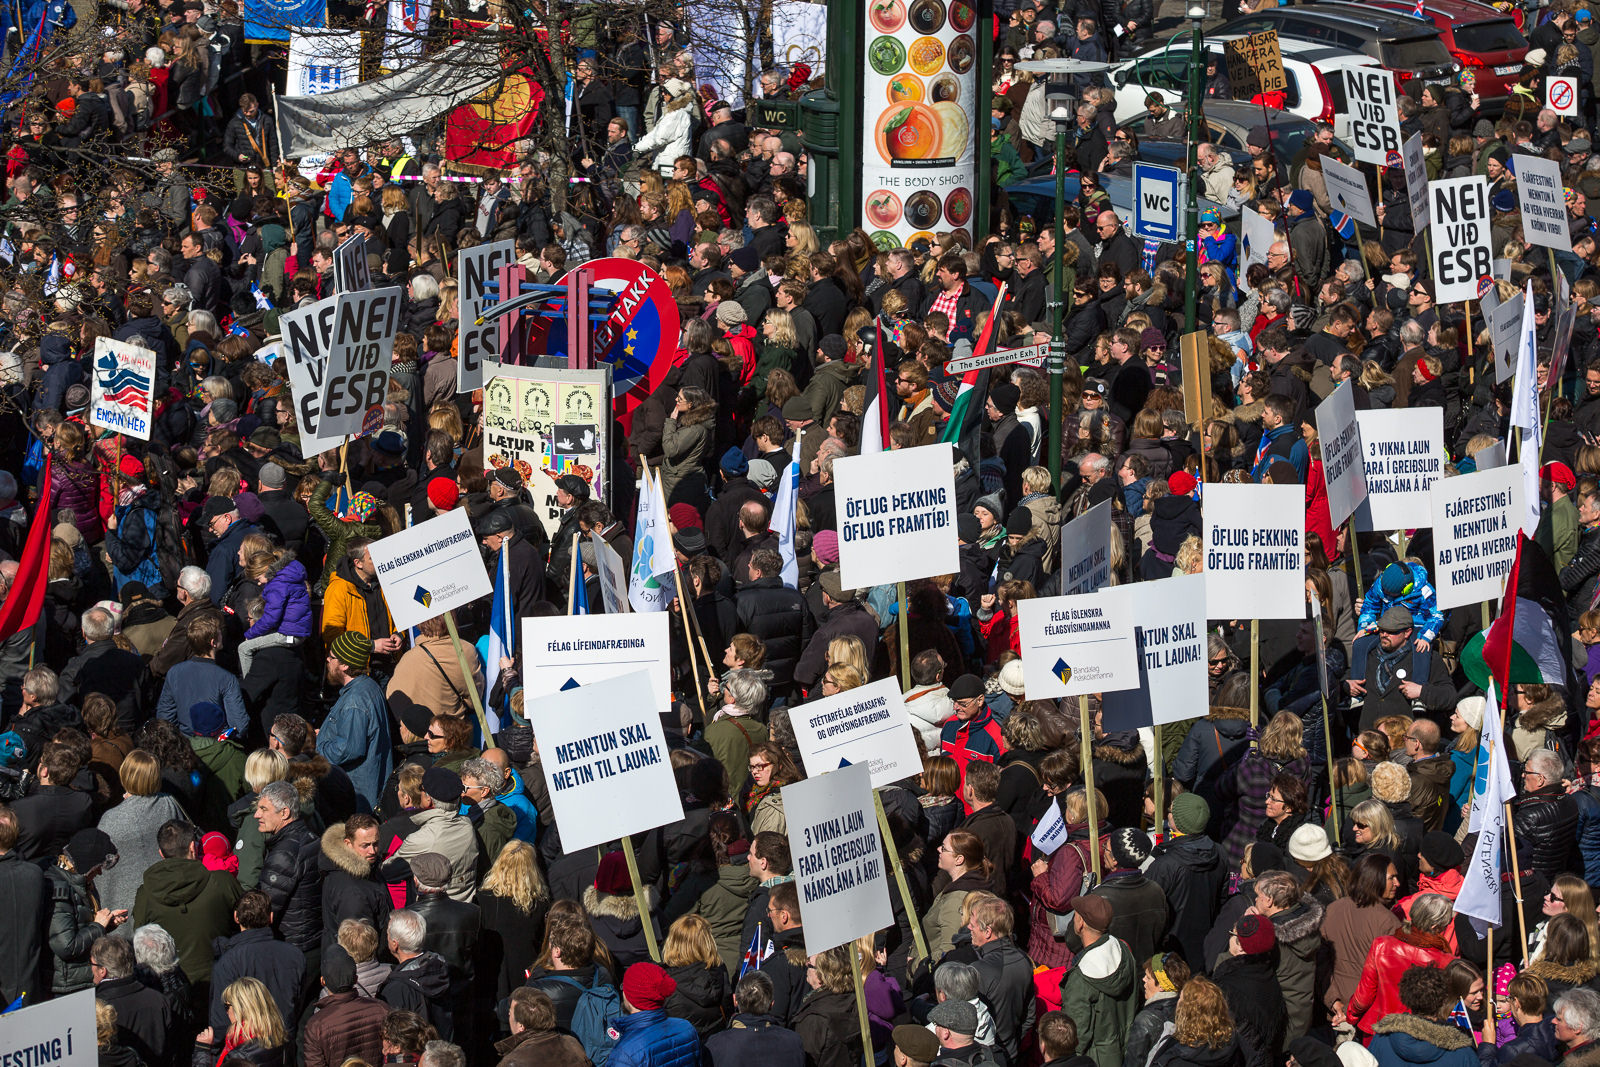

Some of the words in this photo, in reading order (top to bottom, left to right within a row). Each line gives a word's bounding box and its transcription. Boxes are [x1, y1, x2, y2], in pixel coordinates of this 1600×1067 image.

[1346, 70, 1391, 105] NEI
[764, 110, 787, 123] WC
[1356, 101, 1385, 123] VIÐ
[1352, 120, 1399, 153] ESB
[878, 176, 900, 186] THE
[905, 176, 936, 187] BODY
[939, 174, 964, 186] SHOP
[1143, 192, 1170, 212] WC
[1435, 182, 1486, 225] NEI
[1446, 222, 1479, 248] VIÐ
[1438, 246, 1492, 285] ESB
[610, 269, 655, 324] TAKK
[337, 295, 397, 345] NEI
[345, 342, 381, 373] VIÐ
[464, 327, 500, 371] ES
[959, 362, 973, 370] The
[975, 353, 1017, 367] Settlement
[1019, 349, 1036, 358] Exh.
[325, 370, 387, 418] ESB
[96, 407, 124, 427] ENGAN
[127, 416, 146, 433] HER
[488, 432, 535, 453] LÆTUR
[1325, 436, 1341, 463] ÖFLUG
[1370, 442, 1376, 456] 3
[1378, 440, 1406, 456] VIKNA
[1408, 440, 1430, 455] LAUN
[1326, 459, 1343, 485] ÖFLUG
[1386, 457, 1390, 475] Í
[1392, 458, 1439, 474] GREIÐSLUR
[1413, 477, 1420, 492] Á
[846, 497, 888, 518] ÖFLUG
[892, 487, 947, 511] ÞEKKING
[1445, 491, 1506, 518] FJÁRFESTING
[1508, 486, 1512, 505] Í
[843, 521, 885, 542] ÖFLUG
[888, 507, 950, 536] FRAMTÍÐ!
[1212, 524, 1249, 546] ÖFLUG
[1252, 529, 1298, 546] ÞEKKING
[1453, 515, 1499, 540] MENNTUN
[1501, 511, 1508, 529] Á
[377, 561, 396, 575] FÉLAG
[393, 548, 425, 568] ÍSLENSKRA
[1208, 548, 1245, 570] ÖFLUG
[1248, 548, 1300, 570] FRAMTÍÐ!
[1439, 549, 1452, 565] AÐ
[1454, 543, 1480, 562] VERA
[1068, 554, 1094, 584] MENNTUN
[1451, 564, 1484, 586] KRÓNU
[431, 582, 456, 596] Bandalag
[1044, 620, 1111, 636] FÉLAGSVÍSINDAMANNA
[1050, 609, 1070, 622] FÉLAG
[1070, 608, 1103, 620] ÍSLENSKRA
[547, 640, 572, 652] FÉLAG
[573, 638, 645, 651] LÍFEINDAFRÆÐINGA
[1172, 622, 1197, 642] SKAL
[1073, 665, 1100, 674] Bandalag
[1145, 651, 1162, 670] TIL
[1165, 643, 1201, 667] LAUNA!
[809, 707, 854, 729] STÉTTARFÉLAG
[817, 729, 827, 741] OG
[827, 709, 891, 737] UPPLÝSINGAFRÆÐINGA
[555, 731, 619, 765] MENNTUN
[619, 722, 651, 747] SKAL
[552, 763, 595, 792] METIN
[594, 758, 617, 779] TIL
[616, 744, 662, 773] LAUNA!
[804, 827, 812, 847] 3
[812, 818, 842, 845] VIKNA
[841, 809, 865, 835] LAUN
[798, 851, 824, 878] FARA
[824, 844, 830, 868] Í
[831, 832, 877, 866] GREIÐSLUR
[803, 867, 855, 903] NÁMSLÁNA
[855, 860, 863, 885] Á
[863, 857, 880, 882] ÁRI!
[67, 1027, 73, 1056] Í
